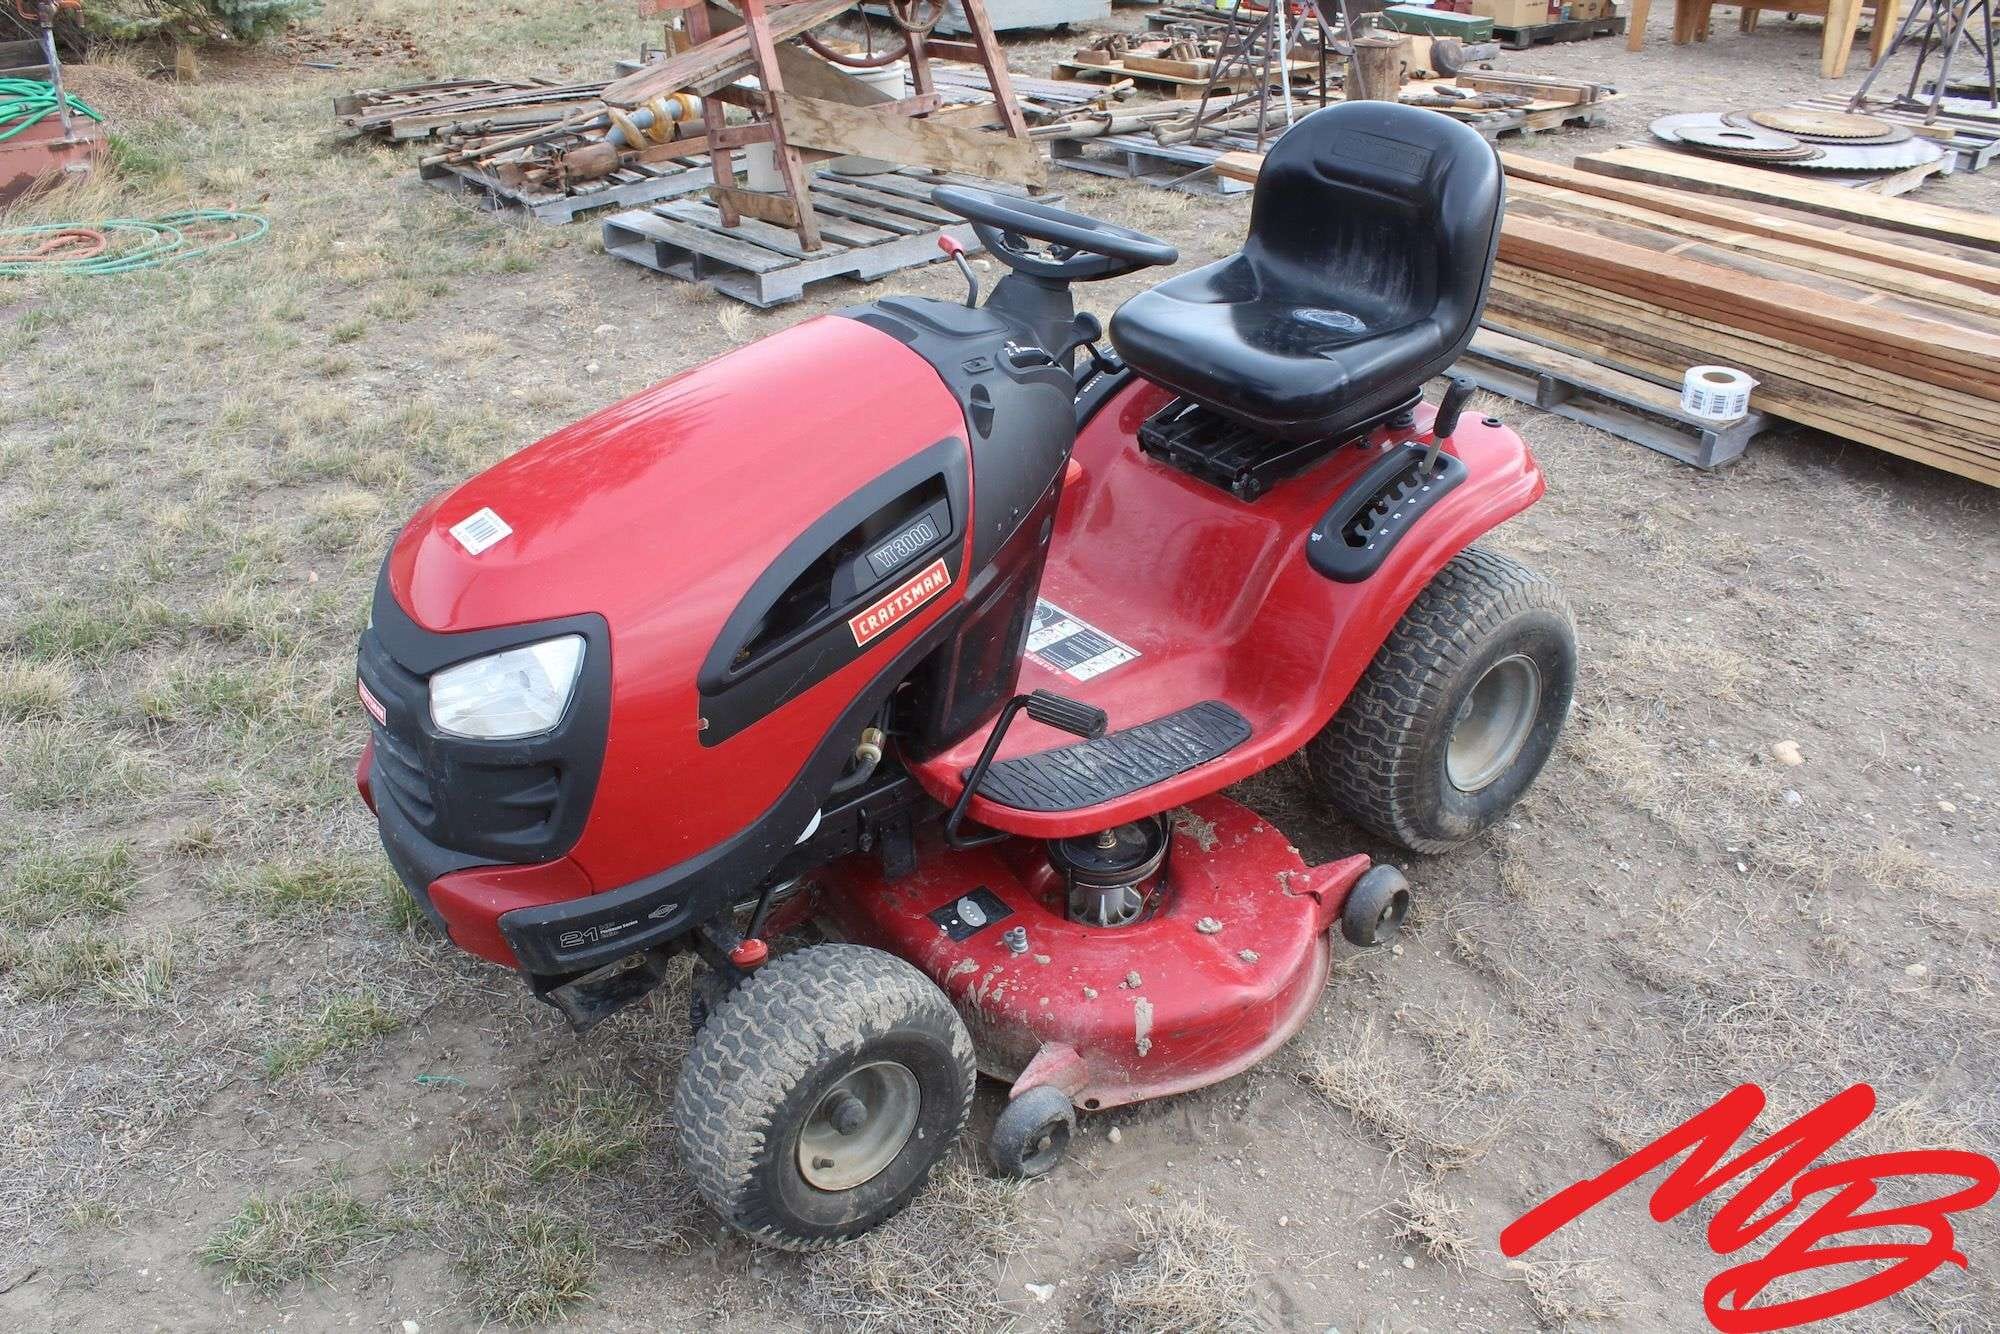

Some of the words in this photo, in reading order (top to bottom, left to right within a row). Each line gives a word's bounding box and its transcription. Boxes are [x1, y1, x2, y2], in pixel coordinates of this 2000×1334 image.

[894, 523, 934, 557] 3000
[858, 569, 944, 636] CRAFTSMAN
[559, 926, 599, 948] 21
